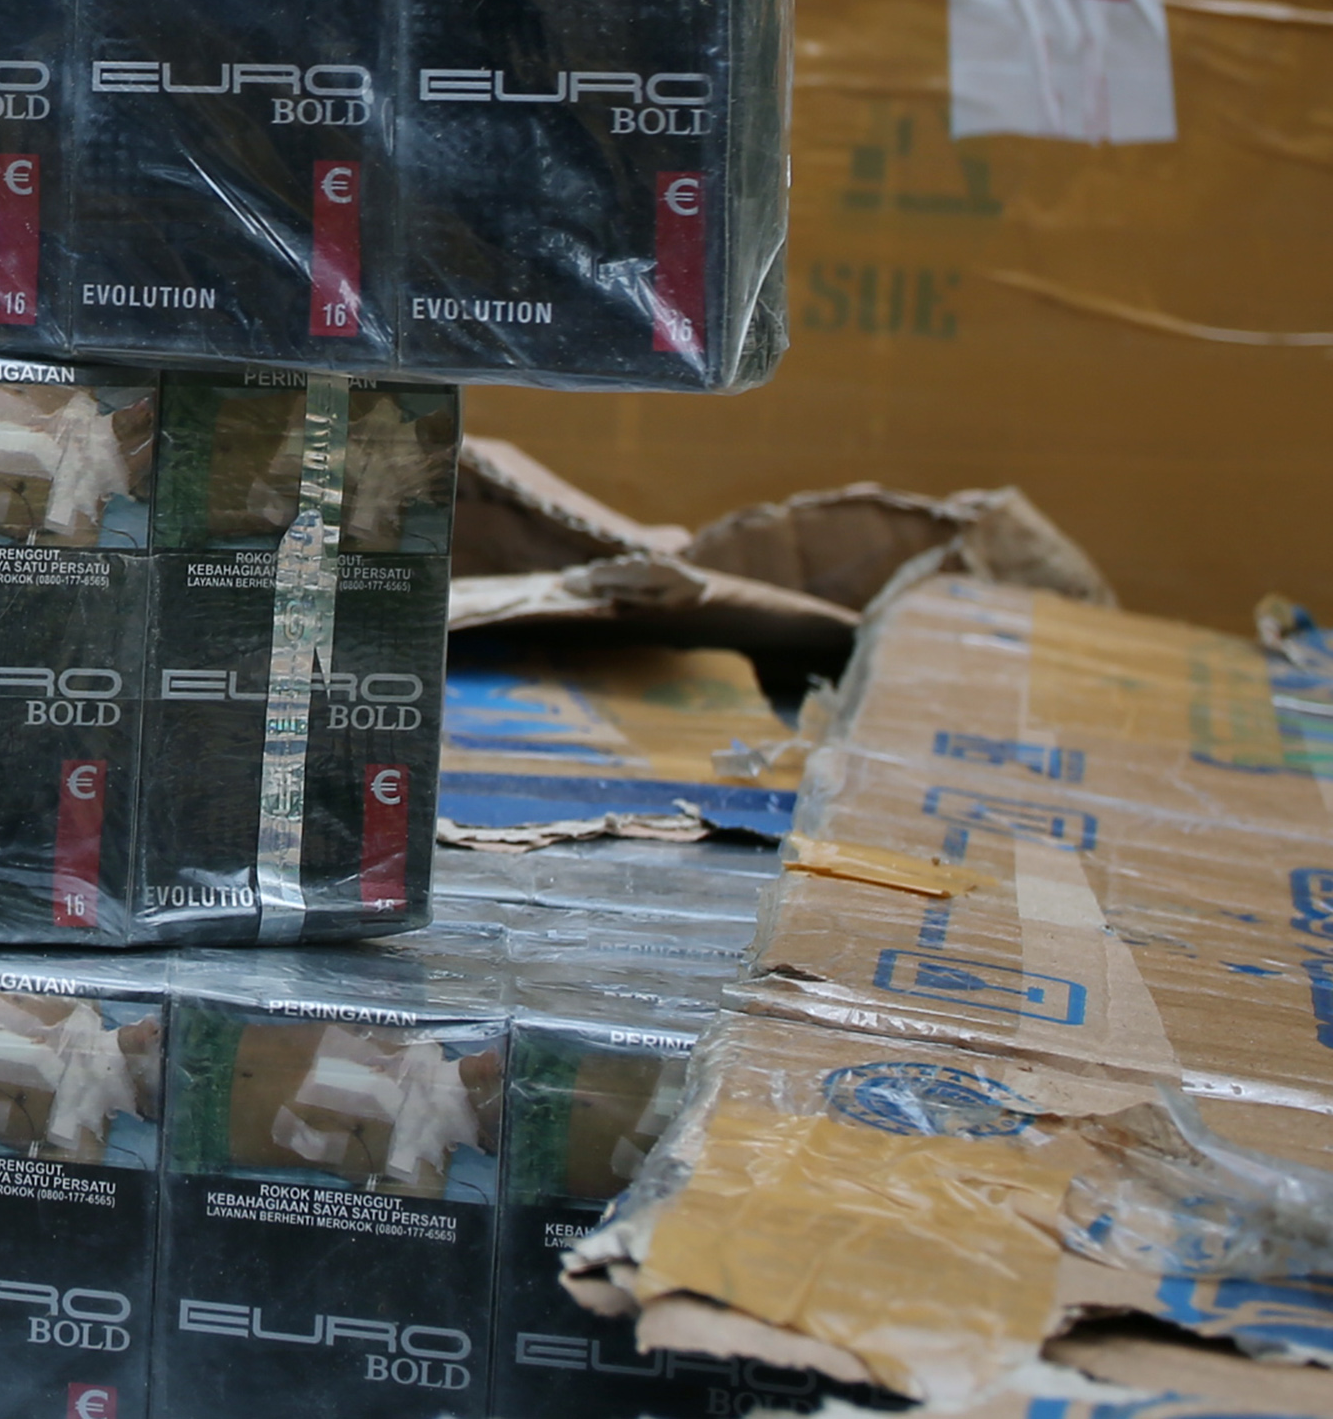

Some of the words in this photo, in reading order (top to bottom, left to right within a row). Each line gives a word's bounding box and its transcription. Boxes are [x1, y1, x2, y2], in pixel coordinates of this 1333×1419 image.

[92, 61, 373, 97] EURO
[420, 69, 712, 105] EURO
[271, 99, 371, 125] BOLD
[611, 107, 713, 135] BOLD
[4, 292, 26, 315] 16
[83, 284, 215, 309] EVOLUTION
[323, 303, 345, 327] 16
[412, 297, 552, 323] EVOLUTION
[14, 561, 46, 572] SATU
[51, 563, 110, 574] PERSATU
[354, 568, 411, 579] PERSATU
[187, 578, 233, 587] LAYANAN
[25, 701, 121, 726] BOLD
[327, 705, 421, 731] BOLD
[64, 893, 84, 916] 16
[269, 1000, 417, 1026] PERINGATAN
[14, 1173, 49, 1186] SATU
[53, 1177, 116, 1195] PERSATU
[260, 1184, 310, 1201] ROKOK
[37, 1189, 115, 1207] (0800-177-6565)
[207, 1192, 309, 1213] KEBAHAGIAAN
[313, 1203, 349, 1218] SAYA
[352, 1207, 387, 1222] SATU
[391, 1212, 456, 1229] PERSATU
[207, 1207, 256, 1219] LAYANAN
[260, 1211, 314, 1226] BERHENTI
[317, 1218, 372, 1233] MEROKOK
[375, 1224, 456, 1242] (0800-177-6565)
[28, 1317, 131, 1351] BOLD
[179, 1299, 471, 1361] EURO
[365, 1353, 470, 1390] BOLD
